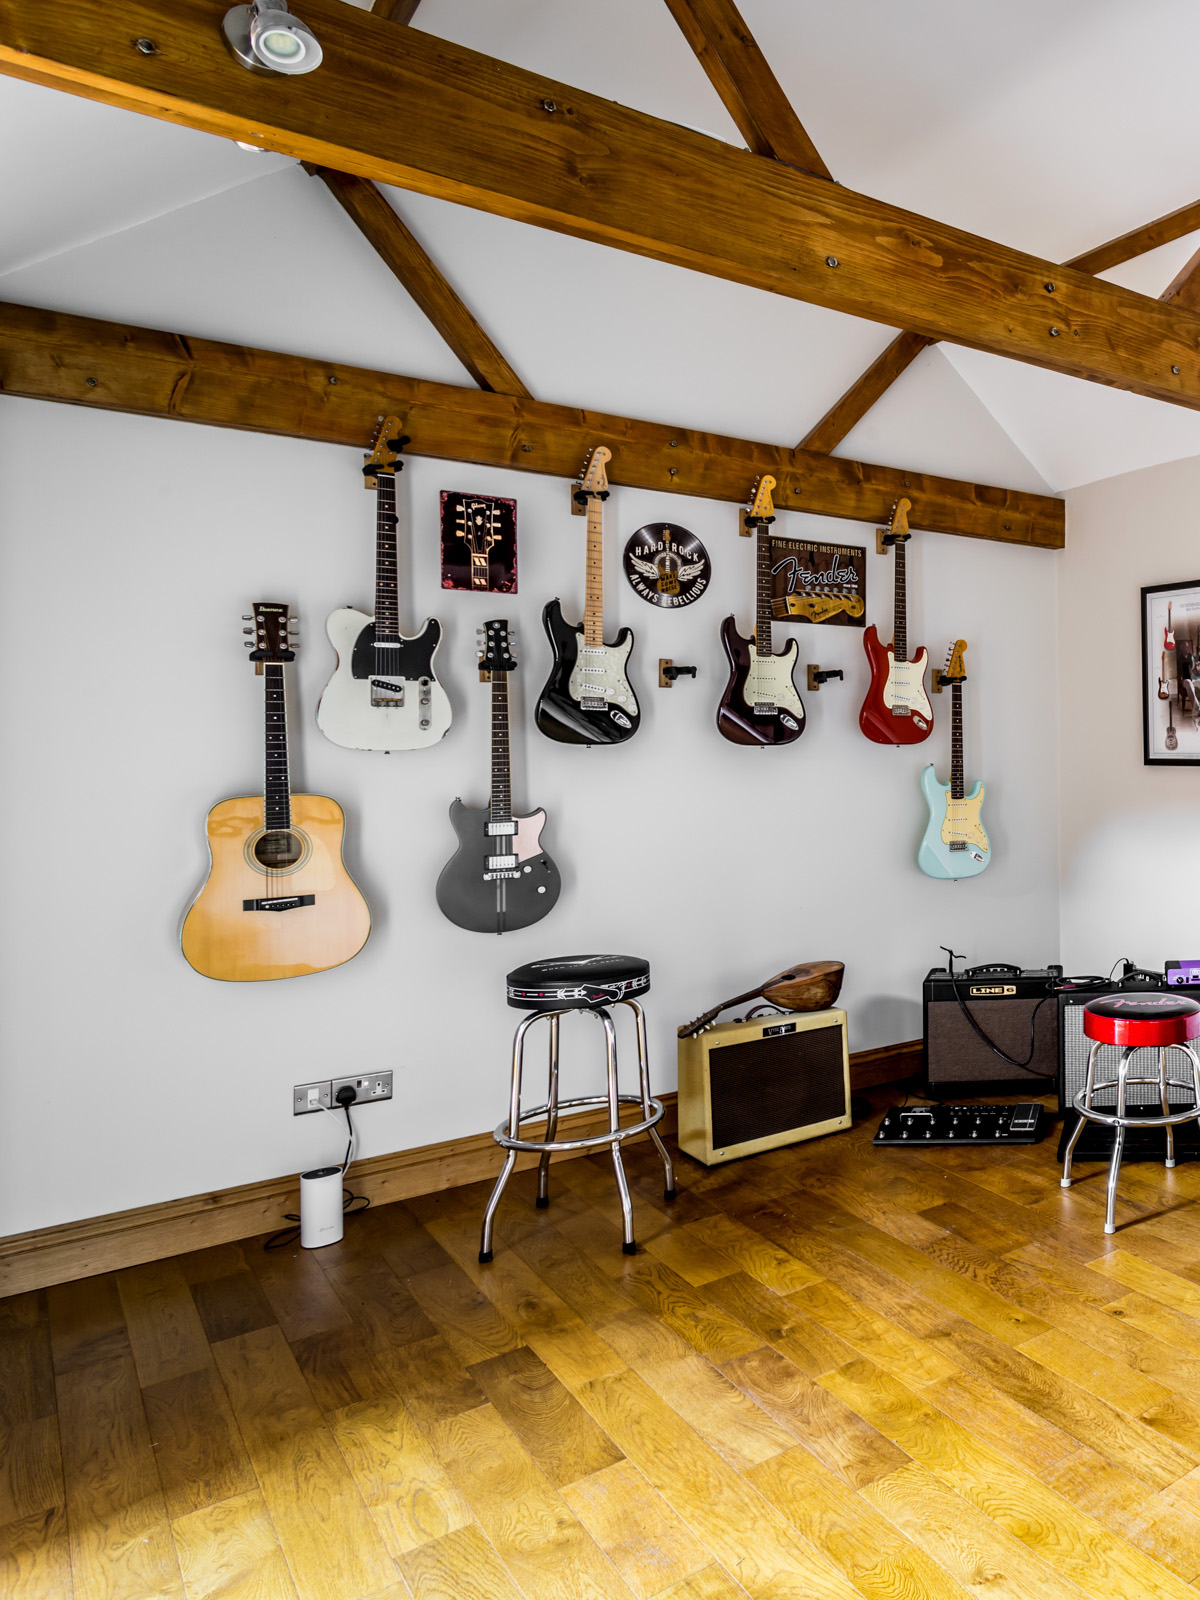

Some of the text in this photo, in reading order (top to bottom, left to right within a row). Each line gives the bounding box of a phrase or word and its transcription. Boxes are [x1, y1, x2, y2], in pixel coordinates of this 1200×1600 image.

[636, 541, 699, 562] HARD ROCK
[772, 540, 862, 557] FINE ELECTRIC INSTRUMENTS
[771, 554, 858, 593] Fender
[629, 574, 707, 607] ALWAYS REBELLIOUS
[811, 607, 828, 619] Fender
[1099, 997, 1187, 1008] Fender
